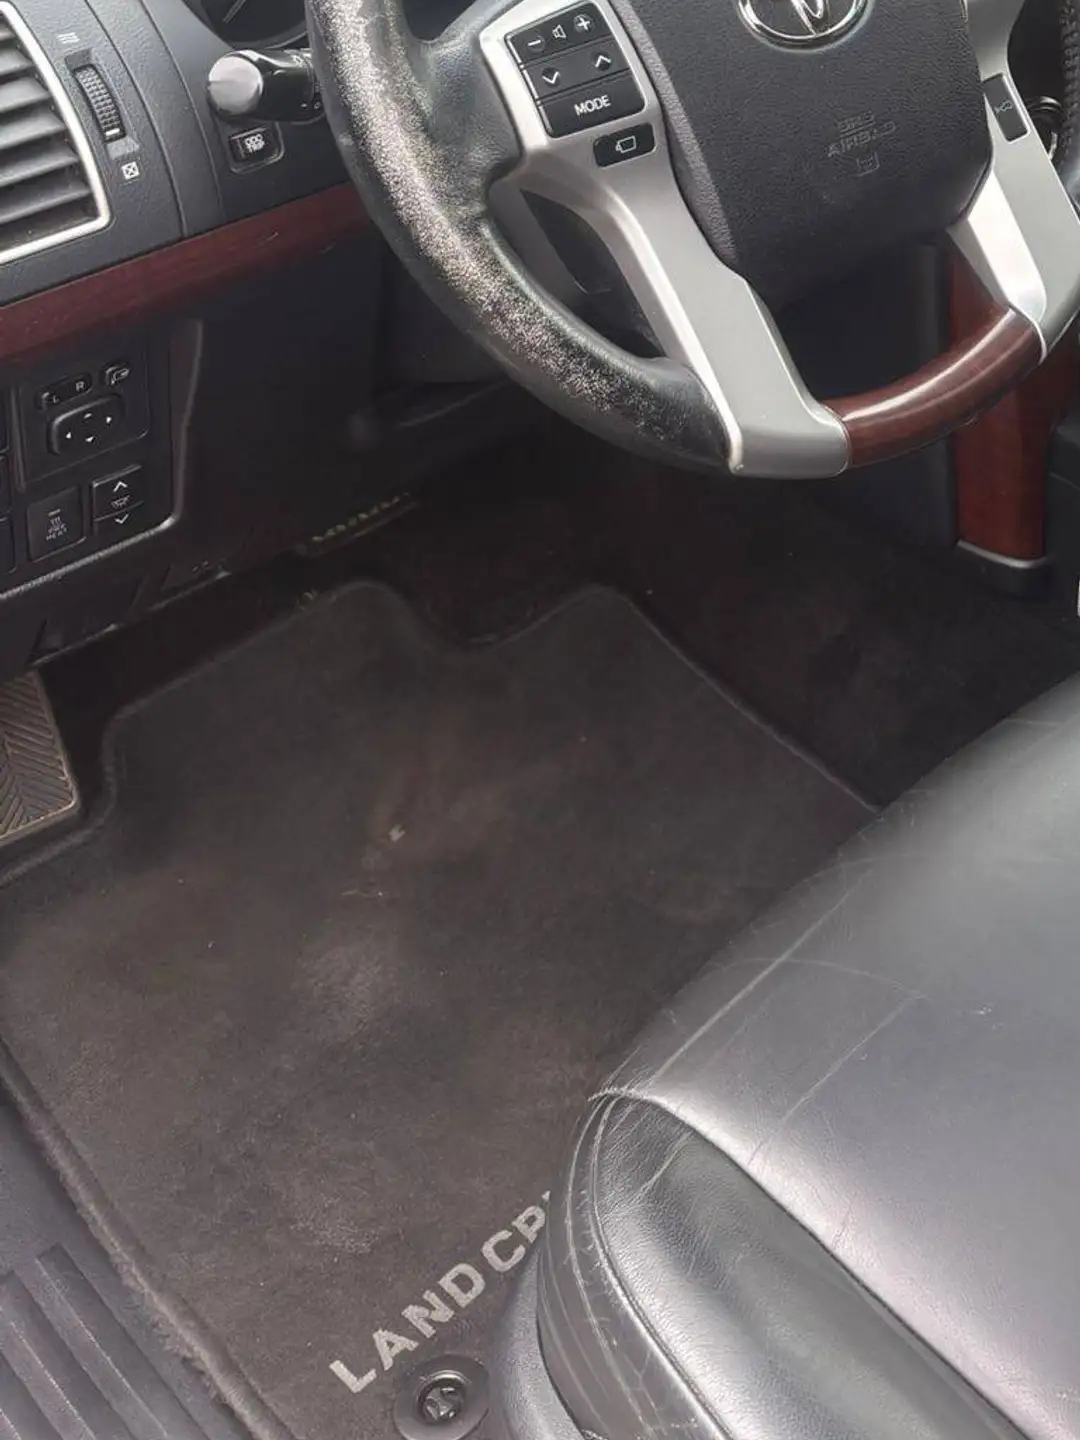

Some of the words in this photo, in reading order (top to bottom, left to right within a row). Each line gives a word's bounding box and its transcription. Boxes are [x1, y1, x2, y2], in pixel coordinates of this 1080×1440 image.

[574, 95, 611, 116] MODE
[76, 381, 85, 392] R
[329, 1263, 486, 1394] LAND
[481, 1191, 550, 1273] CR
